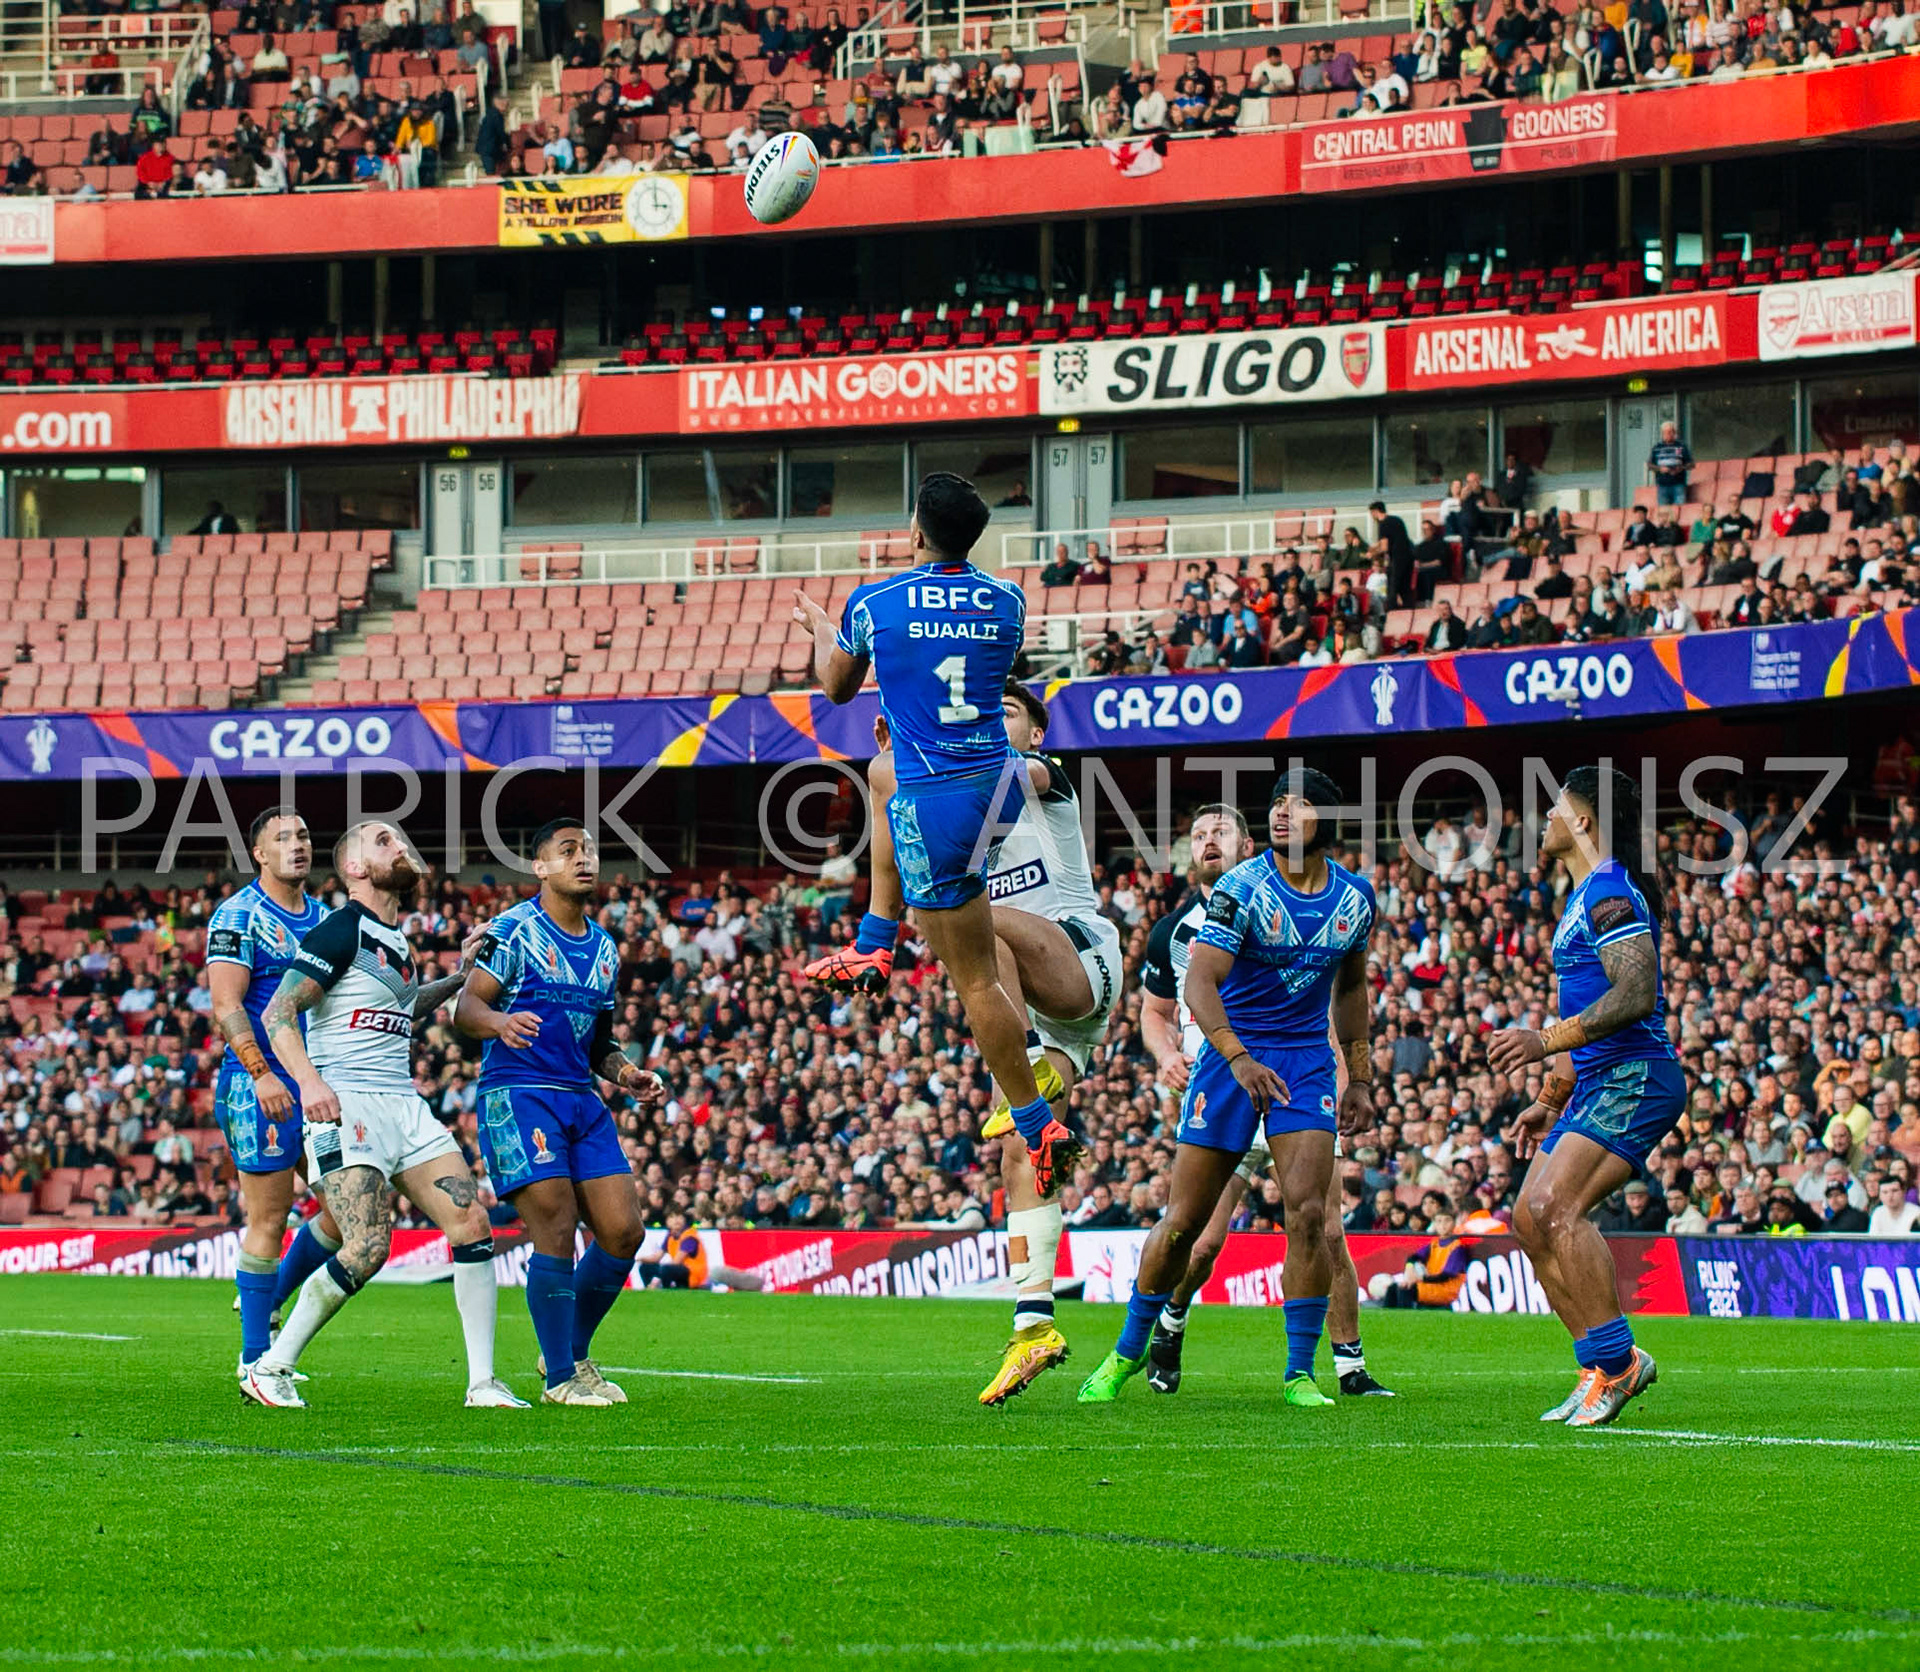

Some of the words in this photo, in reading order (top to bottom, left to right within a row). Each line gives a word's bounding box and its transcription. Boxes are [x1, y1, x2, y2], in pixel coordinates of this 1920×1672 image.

[1313, 126, 1398, 159] CENTRAL
[1403, 120, 1456, 149] PENN
[1513, 102, 1606, 138] GOONERS
[505, 197, 548, 214] SHE
[555, 193, 623, 213] WORE
[1414, 325, 1532, 376] ARSENAL
[1601, 305, 1720, 360] AMERICA
[689, 365, 828, 409] ITALIAN
[837, 354, 1018, 402] GOONERS
[1107, 336, 1326, 403] SLIGO
[226, 382, 347, 444] ARSENAL
[387, 375, 581, 439] PHILADELPHIA
[1053, 448, 1068, 467] 57
[1091, 446, 1106, 465] 57
[907, 585, 994, 611] IBFC
[932, 654, 980, 724] 1
[1093, 681, 1243, 730] CAZOO
[1504, 653, 1634, 706] CAZOO
[209, 716, 391, 760] CAZOO
